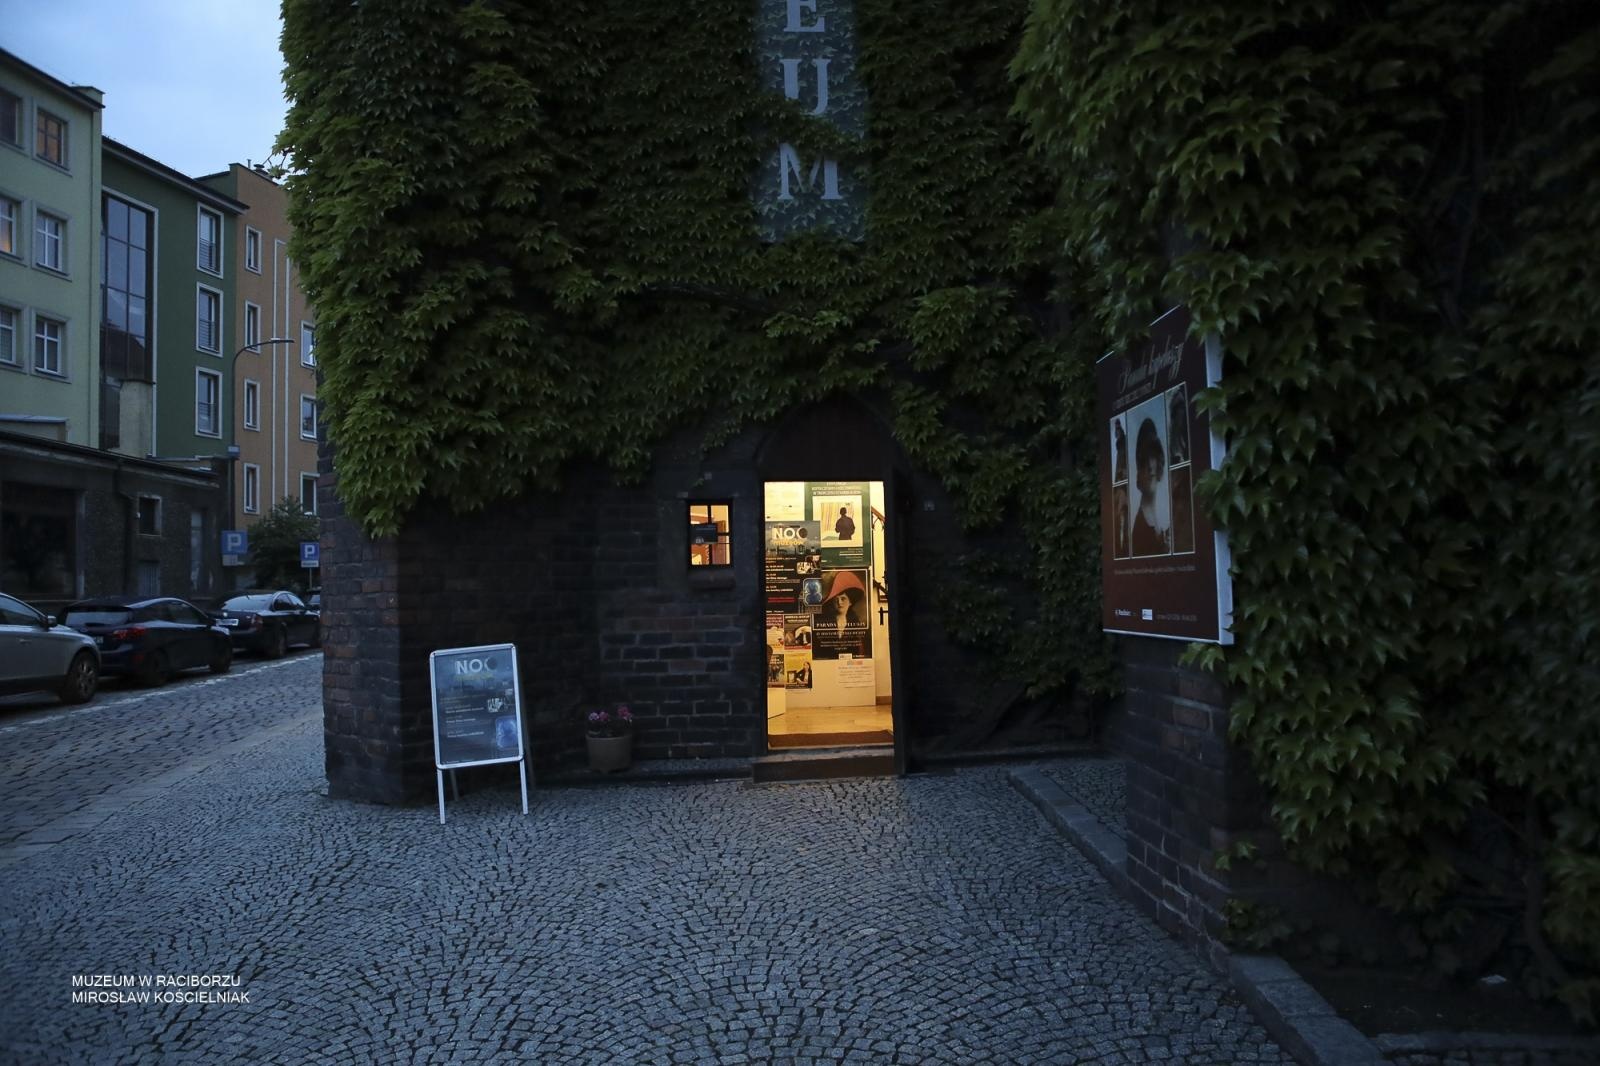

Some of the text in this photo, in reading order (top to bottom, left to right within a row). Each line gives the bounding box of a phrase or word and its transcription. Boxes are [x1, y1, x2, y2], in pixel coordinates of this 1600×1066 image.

[771, 527, 808, 540] NOC
[227, 534, 242, 551] P
[304, 544, 316, 558] P
[455, 658, 497, 674] NOC
